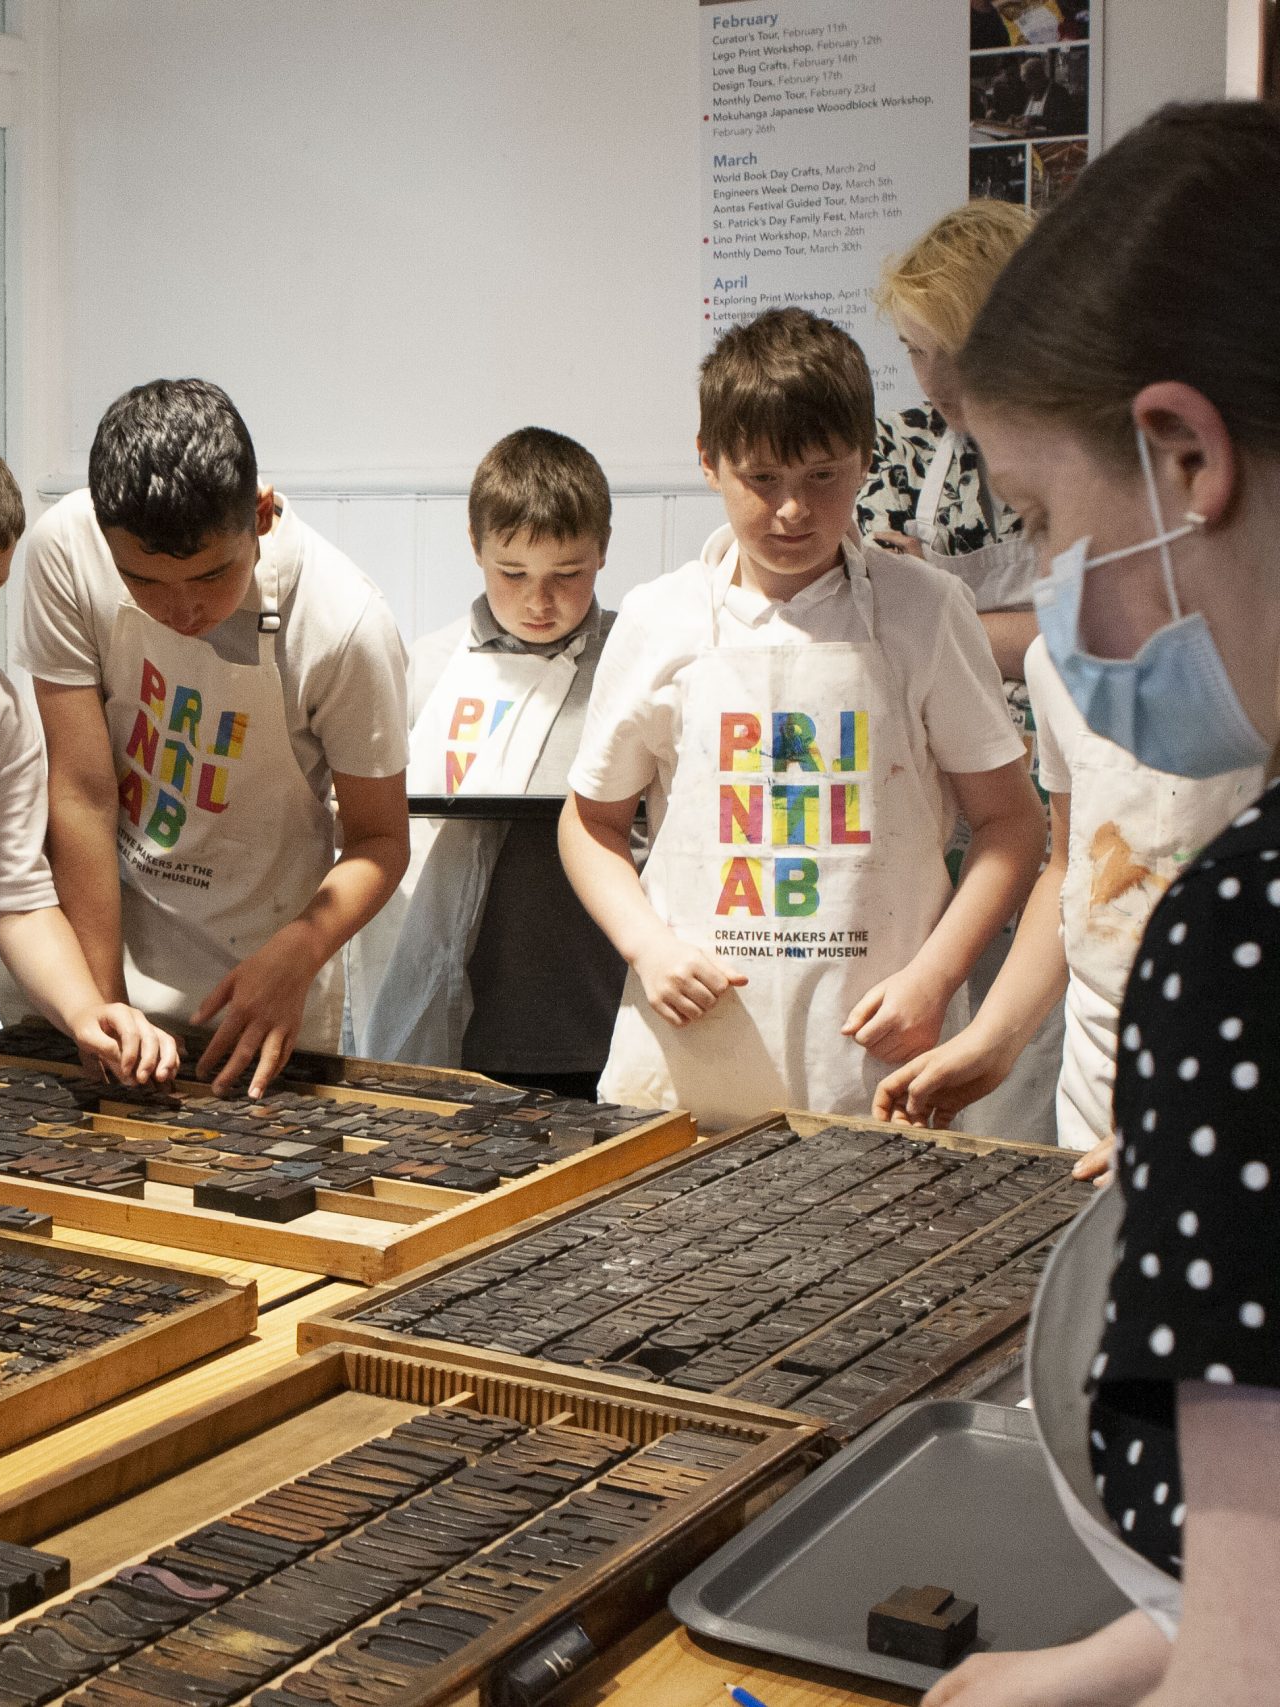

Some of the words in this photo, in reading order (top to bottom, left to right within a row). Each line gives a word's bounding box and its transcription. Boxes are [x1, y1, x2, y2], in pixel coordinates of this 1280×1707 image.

[712, 14, 778, 29] February
[712, 32, 755, 45] Curator's
[758, 31, 780, 41] Tour,
[783, 26, 825, 37] February
[712, 51, 736, 61] Lego
[739, 48, 760, 58] Print
[763, 43, 813, 56] Workshop,
[817, 38, 860, 49] February
[712, 67, 734, 76] Love
[738, 64, 756, 75] Bug
[759, 62, 790, 71] Crafts,
[793, 56, 835, 67] February
[712, 81, 745, 92] Design
[748, 78, 775, 88] Tours,
[779, 74, 819, 84] February
[713, 95, 750, 106] Monthly
[753, 93, 782, 103] Demo
[786, 90, 807, 100] Tour,
[810, 87, 852, 98] February
[854, 82, 876, 93] 23rd
[713, 110, 767, 122] Mokuhanga
[770, 107, 815, 118] Japanese
[881, 95, 934, 106] Workshop,
[713, 125, 753, 136] February
[713, 152, 757, 168] March
[713, 173, 741, 183] World
[744, 171, 767, 181] Book
[770, 169, 789, 180] Day
[791, 166, 822, 177] Crafts,
[825, 163, 855, 174] March
[857, 161, 876, 173] 2nd
[713, 188, 759, 200] Engineers
[761, 184, 787, 195] Week
[791, 182, 819, 192] Demo
[822, 180, 843, 192] Day,
[845, 178, 876, 188] March
[713, 204, 746, 215] Aontas
[749, 200, 784, 212] Festival
[786, 198, 822, 209] Guided
[824, 196, 847, 206] Tour,
[849, 192, 880, 204] March
[713, 219, 725, 229] St.
[728, 217, 766, 229] Patrick's
[769, 215, 787, 226] Day
[790, 212, 820, 224] Family
[823, 211, 846, 222] Fest,
[850, 208, 879, 220] March
[713, 235, 732, 245] Lino
[735, 233, 757, 243] Print
[760, 229, 810, 241] Workshop,
[813, 227, 842, 238] March
[713, 249, 751, 260] Monthly
[753, 247, 782, 257] Demo
[785, 245, 807, 256] Tour,
[810, 242, 839, 254] March
[713, 275, 748, 292] April
[713, 295, 757, 307] Exploring
[760, 293, 781, 303] Print
[784, 290, 835, 301] Workshop,
[838, 288, 860, 300] April
[820, 306, 843, 316] April
[140, 657, 250, 759] PRI
[719, 711, 871, 772] PRI
[126, 709, 229, 813] NTL
[118, 768, 187, 851] AB
[719, 784, 871, 845] NTL
[136, 843, 172, 869] MAKERS
[175, 863, 190, 871] AT
[192, 865, 214, 878] THE
[131, 857, 160, 878] PRINT
[162, 871, 210, 890] MUSEUM
[715, 856, 820, 917] AB
[715, 930, 771, 942] CREATIVE
[774, 931, 826, 943] MAKERS
[829, 931, 846, 942] AT
[847, 930, 869, 942] THE
[715, 945, 773, 957] NATIONAL
[777, 946, 813, 958] PRINT
[817, 946, 868, 958] MUSEUM
[544, 1650, 574, 1680] 16
